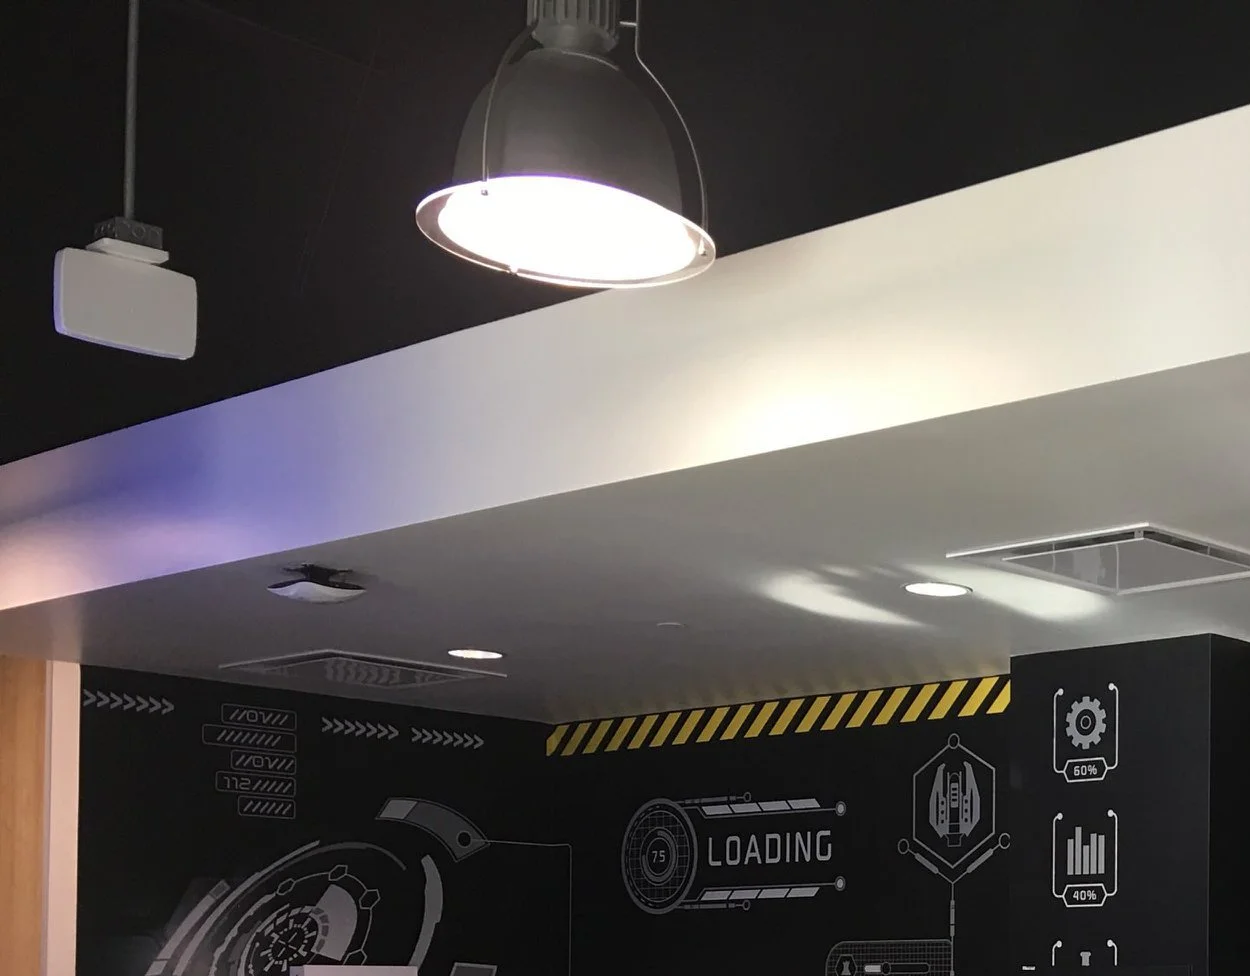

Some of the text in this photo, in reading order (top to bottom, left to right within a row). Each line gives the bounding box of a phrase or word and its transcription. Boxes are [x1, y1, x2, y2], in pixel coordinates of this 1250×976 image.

[1073, 764, 1098, 776] 60%
[708, 830, 832, 867] LOADING
[651, 849, 666, 864] 75
[1072, 889, 1097, 901] 40%
